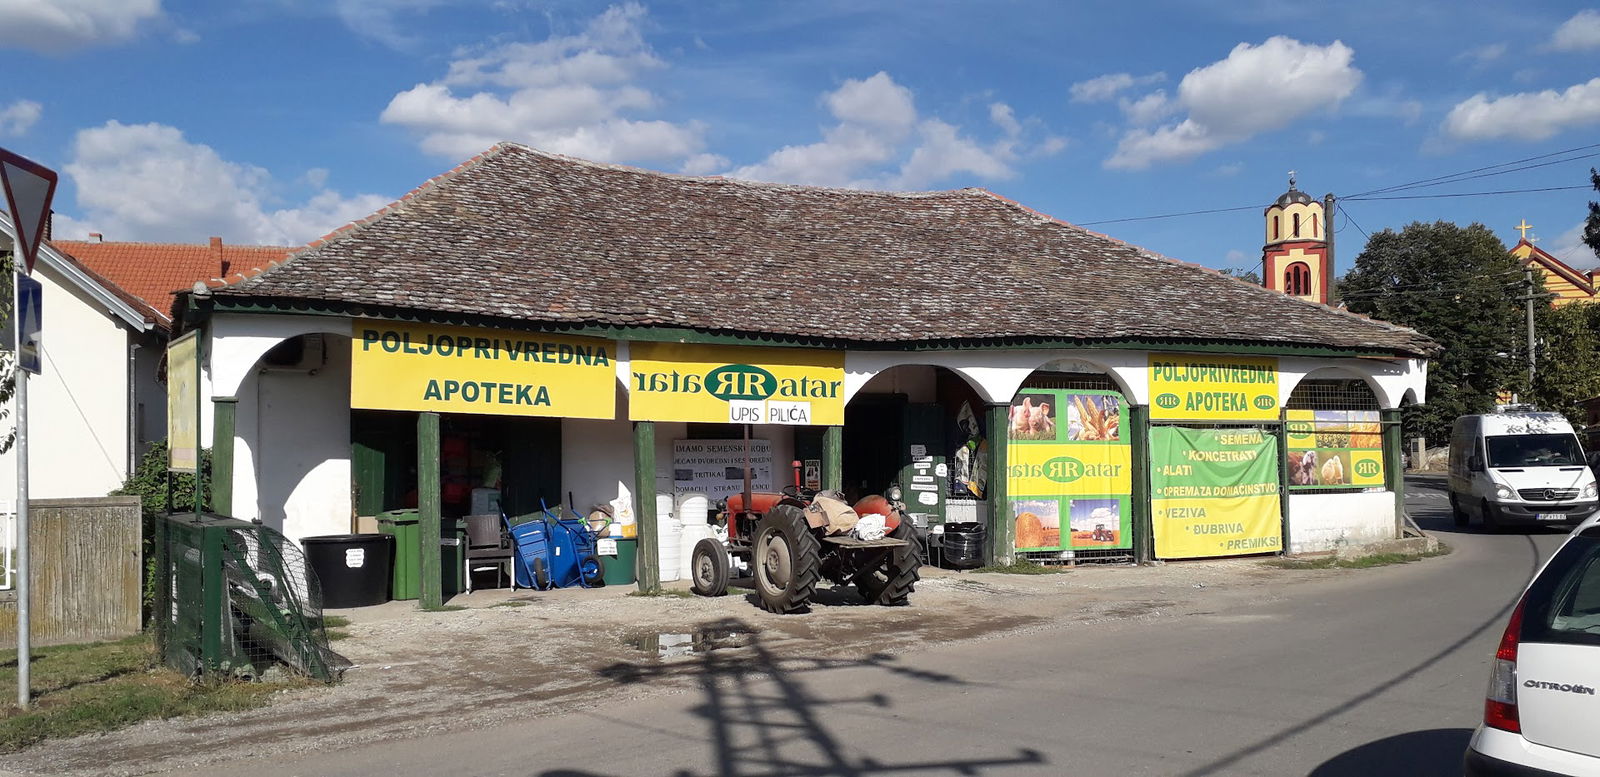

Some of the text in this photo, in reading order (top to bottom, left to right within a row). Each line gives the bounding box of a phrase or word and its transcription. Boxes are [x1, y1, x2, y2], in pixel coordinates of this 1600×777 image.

[362, 329, 609, 367] POLJOPRIVREDNA
[1153, 362, 1275, 384] POLJOPRIVREDNA
[423, 379, 551, 407] APOTEKA
[1185, 392, 1248, 411] APOTEKA
[731, 405, 808, 423] UPIS PILIĆA
[1220, 433, 1264, 445] SEMENA
[675, 445, 703, 453] IMAMO
[1188, 450, 1257, 462] KONCETRATI
[1162, 464, 1193, 476] ALATI
[1163, 486, 1199, 497] OPREMA
[1200, 485, 1212, 497] ZA
[1165, 507, 1206, 518] VEZIVA
[1193, 523, 1244, 535] ĐUBRIVA
[1227, 537, 1279, 550] PREMIKSI
